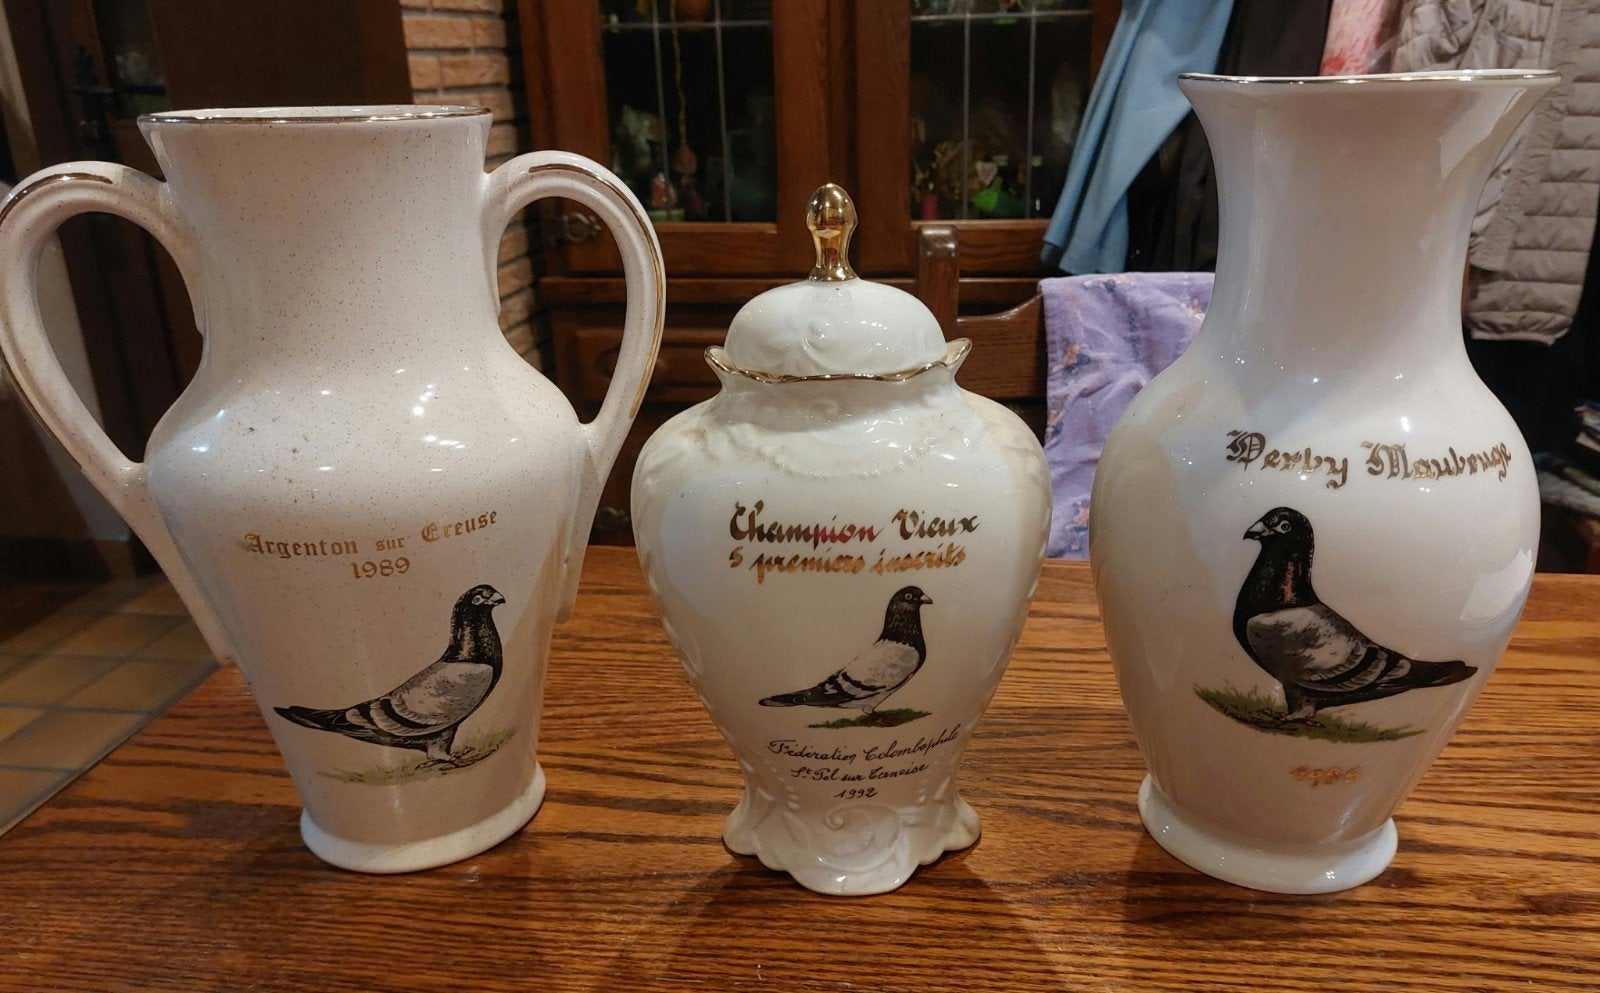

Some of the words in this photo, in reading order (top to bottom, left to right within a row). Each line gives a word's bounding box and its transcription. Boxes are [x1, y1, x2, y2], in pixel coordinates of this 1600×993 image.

[1225, 430, 1348, 489] Derby
[243, 533, 358, 559] Argenton
[375, 536, 405, 552] sur
[421, 510, 498, 543] Creuse
[729, 500, 885, 550] Champion
[891, 508, 982, 540] Vieux
[350, 556, 410, 579] 1989
[833, 787, 878, 799] 1992
[841, 772, 866, 782] sur
